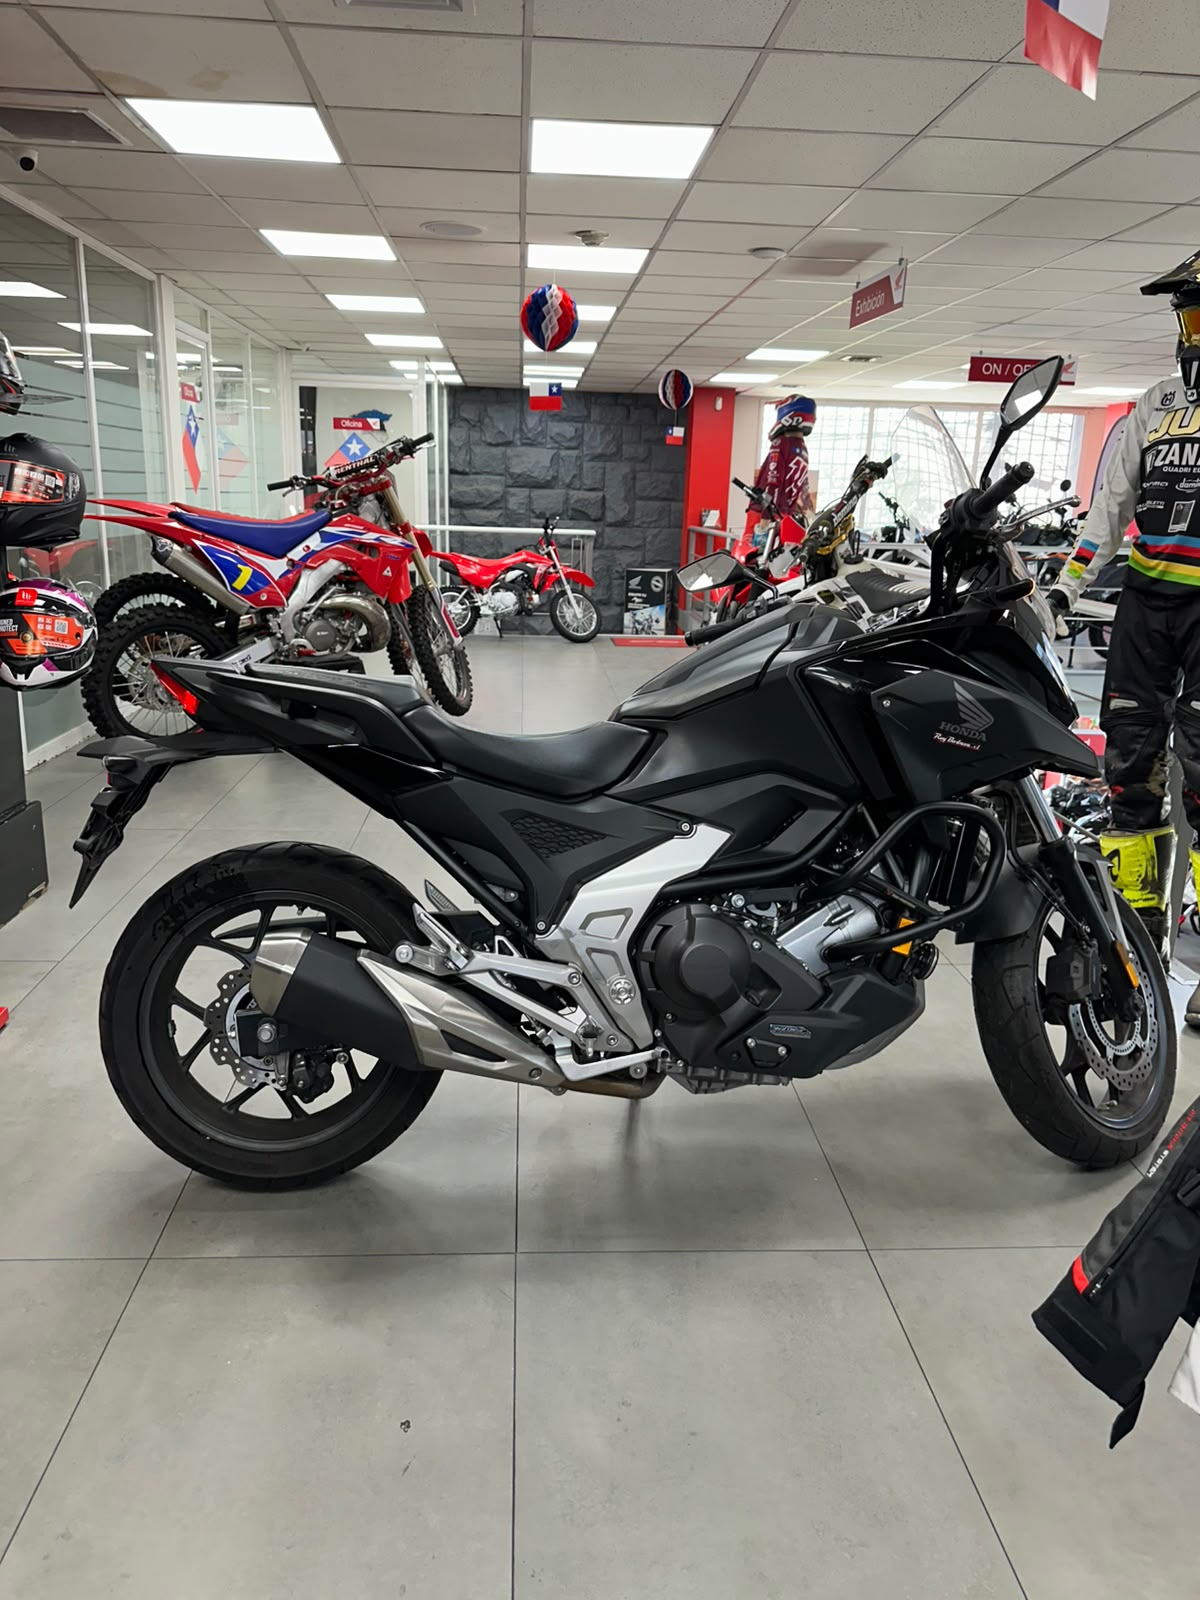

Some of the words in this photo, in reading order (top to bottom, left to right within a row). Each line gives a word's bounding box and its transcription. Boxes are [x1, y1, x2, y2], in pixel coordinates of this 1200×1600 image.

[855, 290, 885, 317] Exhibición
[982, 362, 1002, 375] ON
[1012, 363, 1036, 376] OF
[939, 720, 987, 742] HONDA
